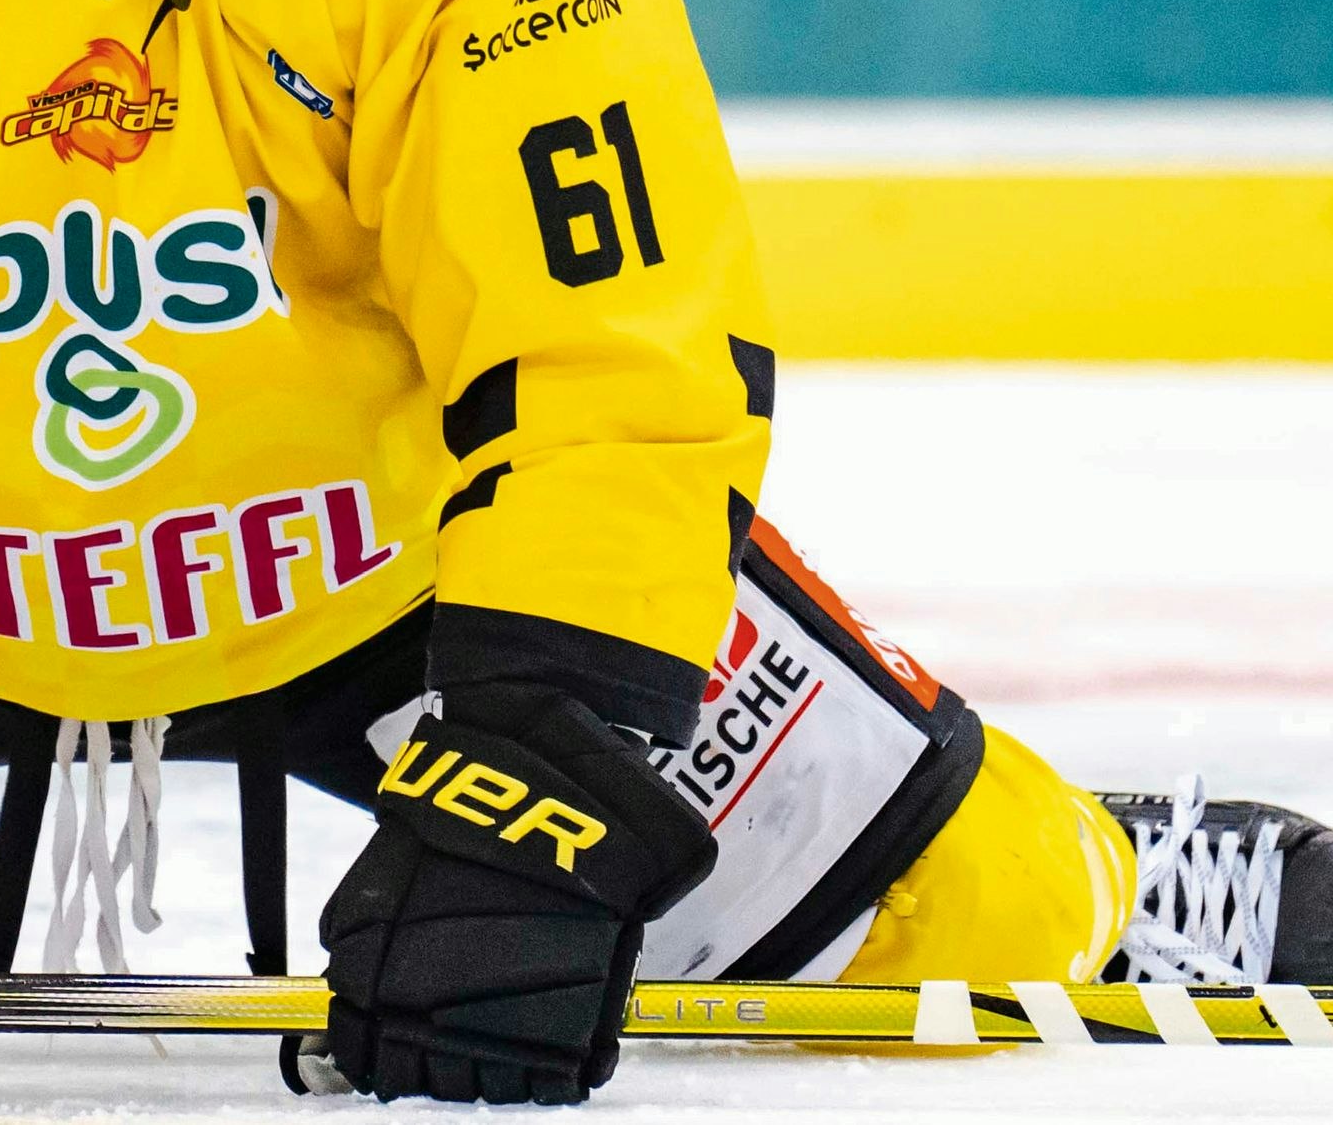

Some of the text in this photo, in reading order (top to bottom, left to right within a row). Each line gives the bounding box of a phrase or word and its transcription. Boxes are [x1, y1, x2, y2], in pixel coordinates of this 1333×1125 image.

[3, 83, 179, 144] capitals
[31, 81, 94, 108] vienna
[517, 100, 666, 288] 61
[378, 740, 608, 874] UER
